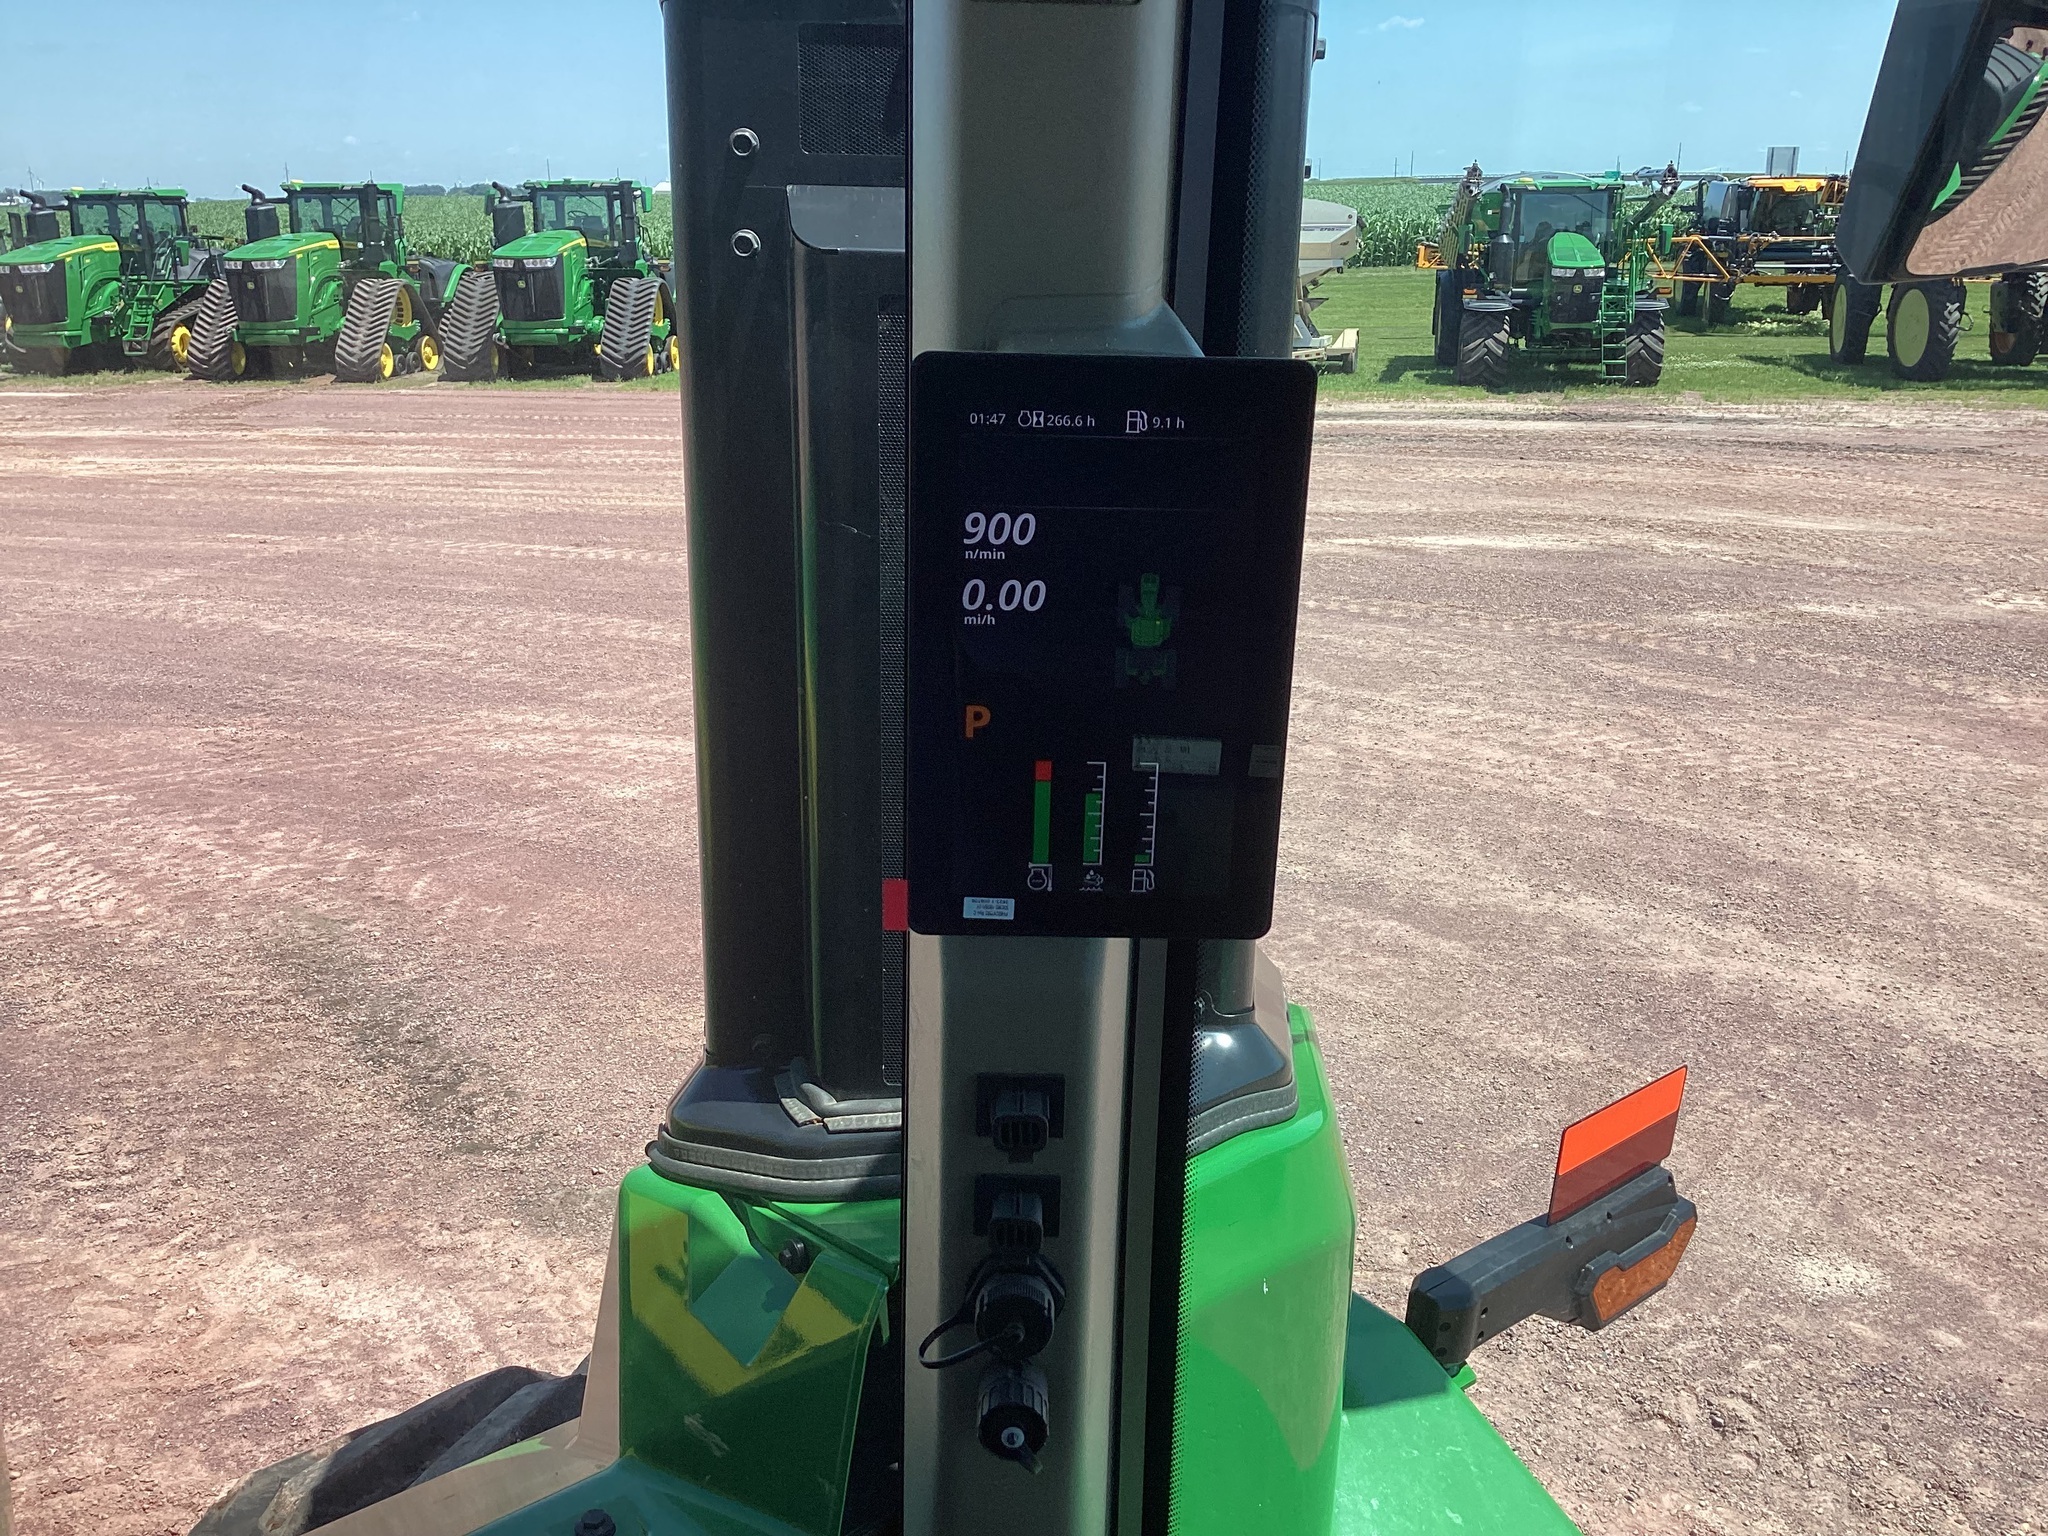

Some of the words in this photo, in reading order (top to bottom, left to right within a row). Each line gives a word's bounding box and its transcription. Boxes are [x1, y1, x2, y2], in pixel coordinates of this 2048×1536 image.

[969, 412, 1006, 425] 01:47
[1046, 414, 1083, 427] 266.6
[1086, 414, 1095, 427] h
[1152, 416, 1171, 429] 9.1
[1176, 416, 1185, 429] h
[963, 511, 1037, 545] 900
[964, 548, 1006, 560] n/min
[962, 578, 1047, 612] 0.00
[964, 613, 996, 625] mi/h
[965, 704, 992, 738] P
